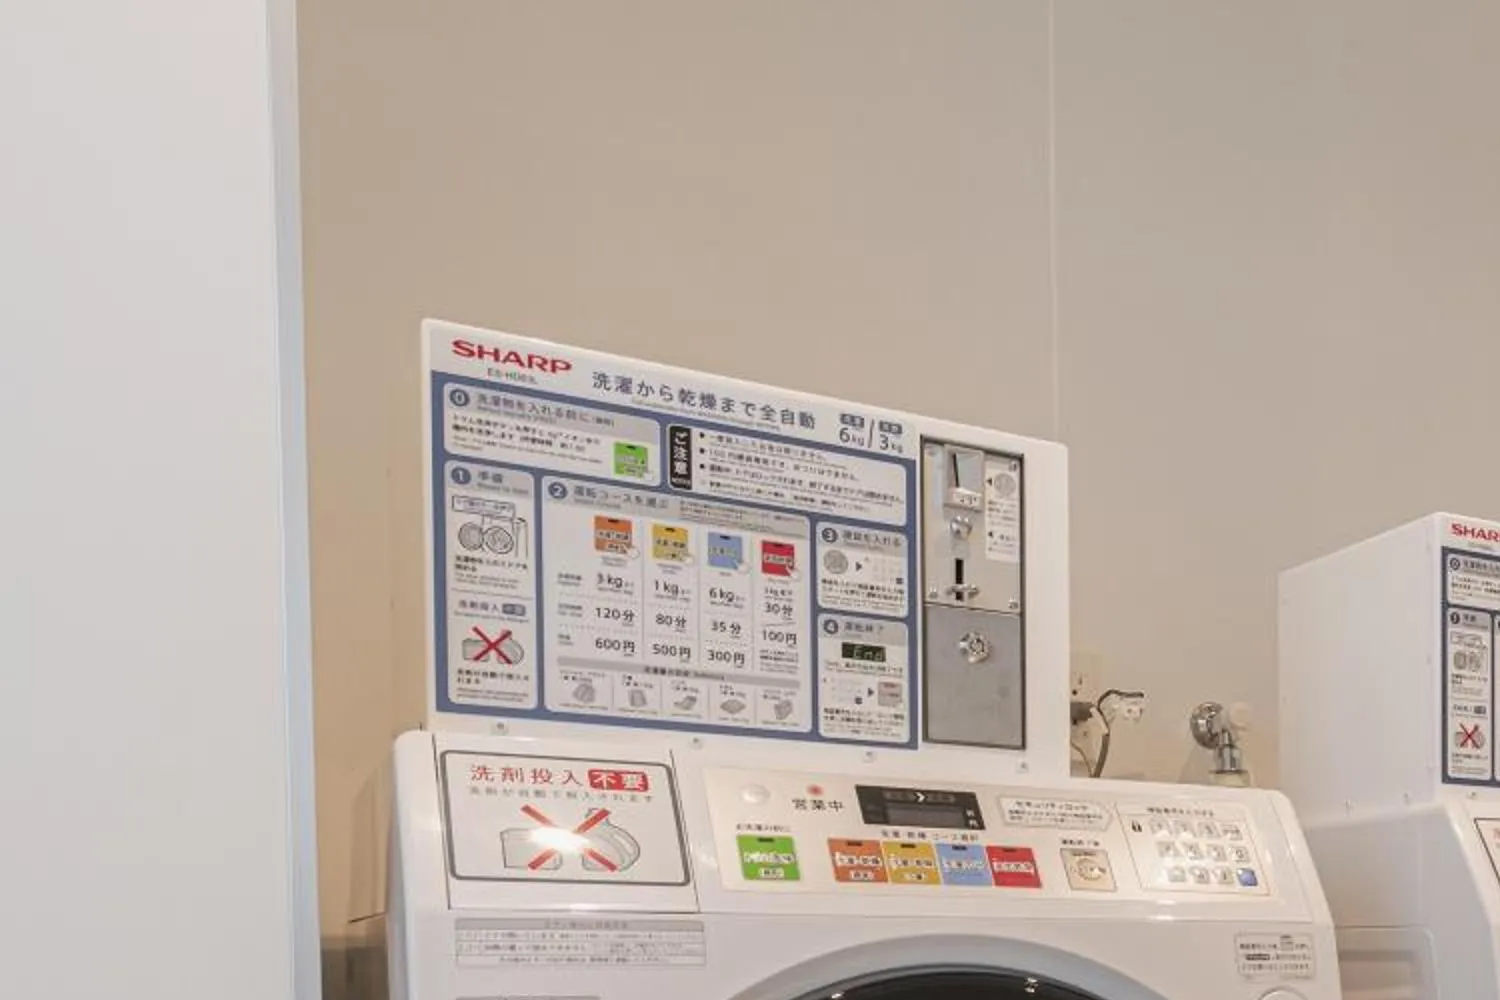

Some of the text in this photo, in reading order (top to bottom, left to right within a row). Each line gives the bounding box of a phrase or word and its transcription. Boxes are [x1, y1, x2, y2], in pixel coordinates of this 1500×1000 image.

[451, 338, 573, 374] SHARP
[591, 370, 816, 430] 洗濯から乾燥まで全自動
[595, 607, 635, 622] 120分
[655, 613, 687, 628] 80分
[762, 629, 797, 645] 100円
[595, 638, 635, 653] 600円
[652, 643, 691, 660] 500円
[707, 649, 745, 666] 300円
[470, 763, 647, 791] 洗剤投入 不要
[791, 798, 846, 813] 営業中
